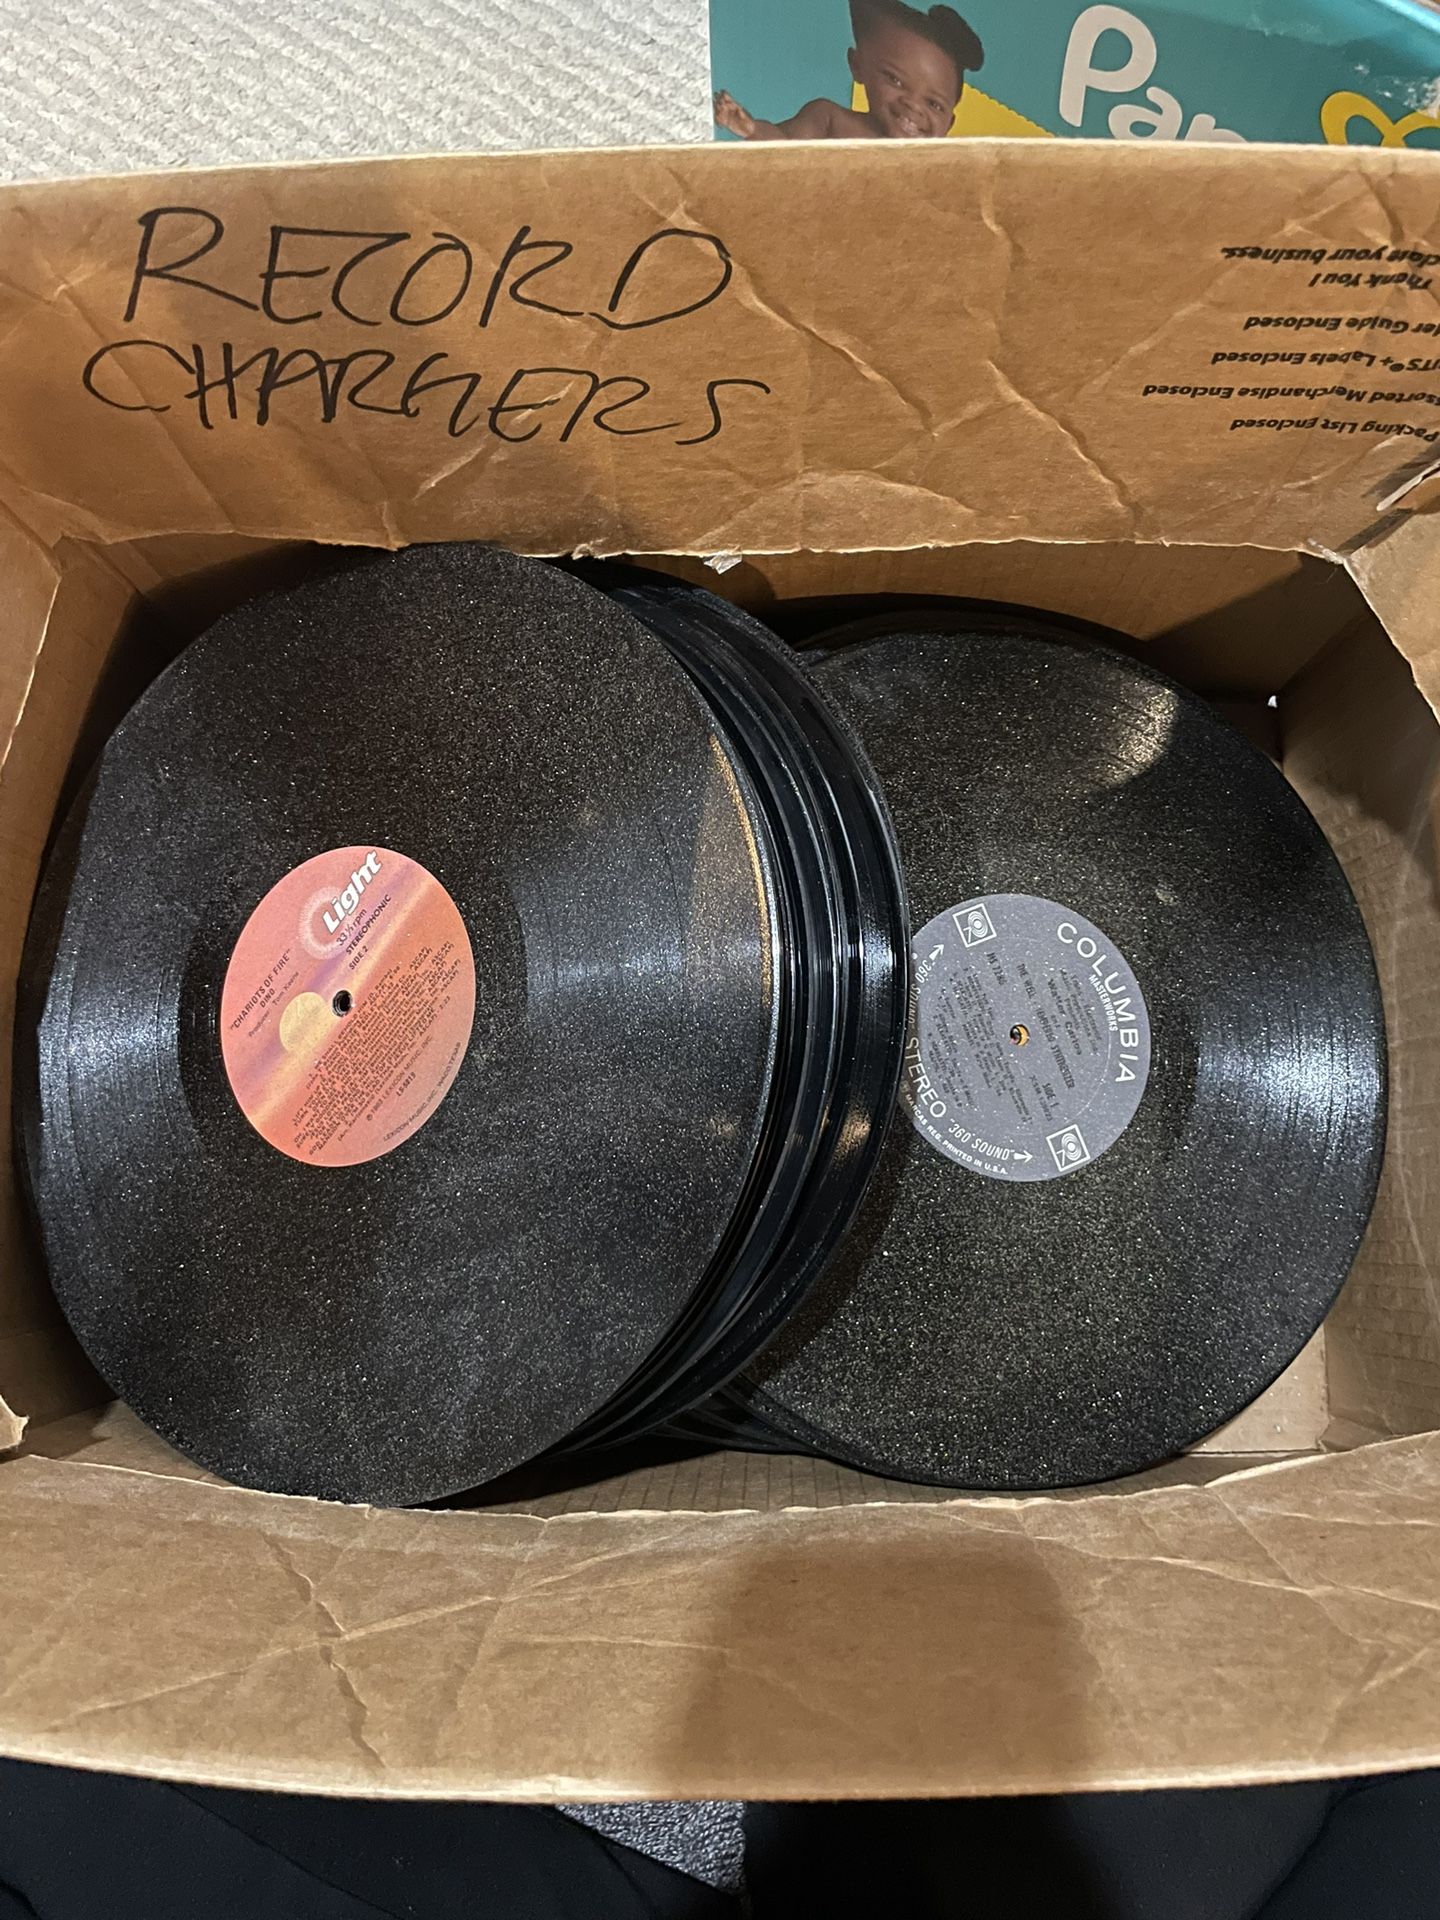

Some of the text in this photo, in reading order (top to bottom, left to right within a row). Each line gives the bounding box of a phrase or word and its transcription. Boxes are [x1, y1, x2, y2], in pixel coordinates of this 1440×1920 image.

[1327, 245, 1388, 262] your
[122, 206, 732, 330] RECORD
[1365, 272, 1433, 290] Thank
[1243, 316, 1342, 331] Enclosed
[1345, 315, 1410, 334] Guide
[1211, 352, 1307, 365] Enclosed
[1310, 350, 1377, 367] Labels
[82, 340, 771, 445] CHARGERS
[1142, 384, 1234, 398] Enclosed
[1238, 385, 1368, 402] Merchandise
[1230, 417, 1440, 443] Packing List Enclosed
[322, 850, 383, 932] Light
[344, 893, 392, 955] STEREOPHONIC
[348, 944, 368, 970] SIDE 2
[262, 972, 275, 988] OF
[259, 986, 276, 1008] DINO
[1057, 922, 1138, 1082] COLUMBIA
[1088, 974, 1118, 1032] MASTERWORKS
[905, 1037, 947, 1118] STEREO
[905, 1094, 928, 1125] MARCAS
[927, 1125, 943, 1142] REG.
[942, 1140, 972, 1162] PRINTED
[973, 1159, 983, 1167] IN
